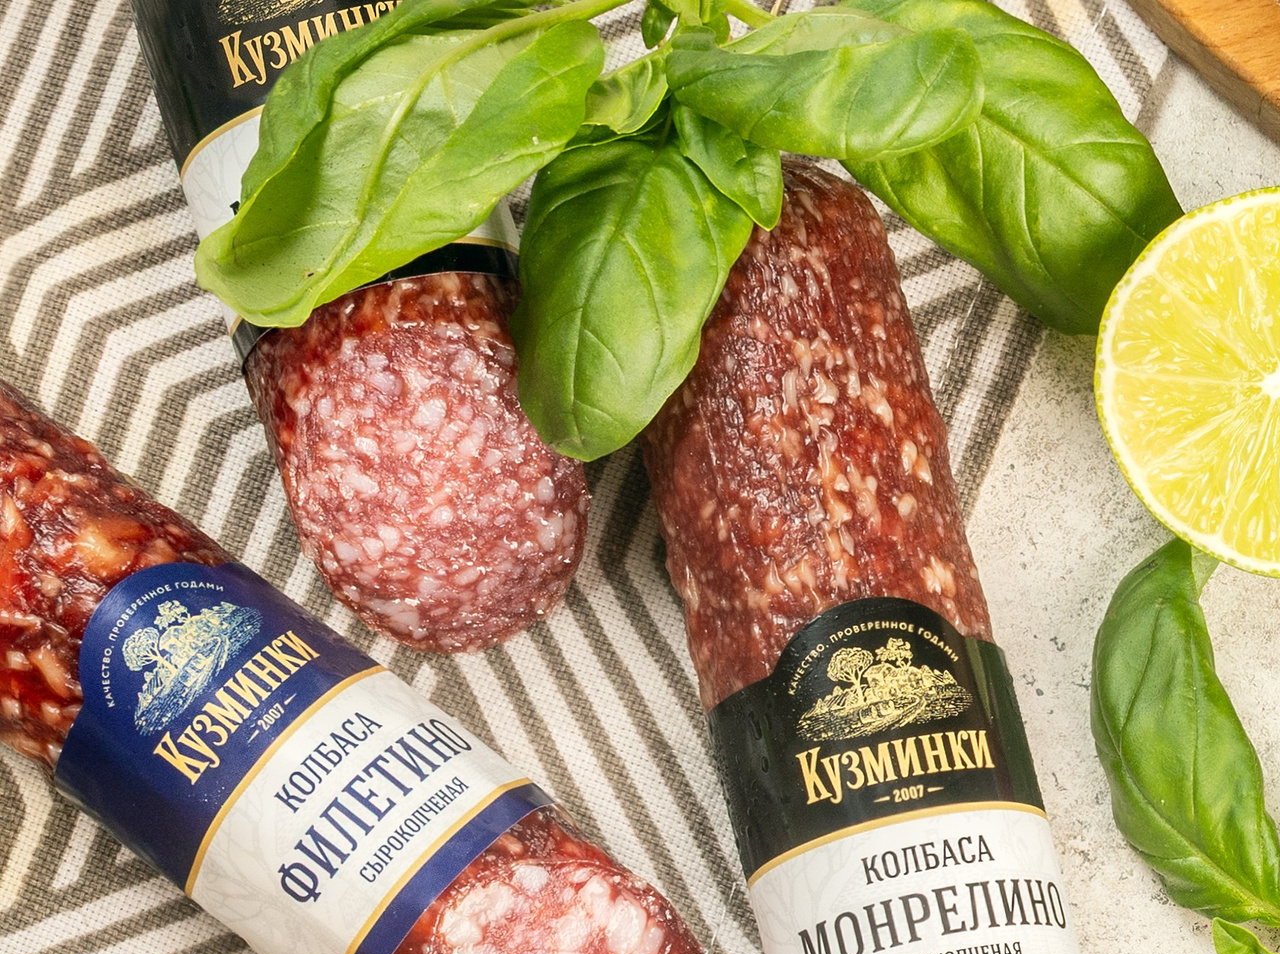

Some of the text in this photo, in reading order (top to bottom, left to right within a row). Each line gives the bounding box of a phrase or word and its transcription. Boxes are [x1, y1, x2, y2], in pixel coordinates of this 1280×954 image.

[219, 0, 402, 88] Кузмин
[108, 584, 172, 642] ПРОВЕРЕННОЕ
[174, 580, 224, 592] ГОДАМИ
[829, 620, 915, 643] ПРОВЕРЕННОЕ
[917, 627, 959, 663] ГОДАМИ
[257, 703, 286, 732] 2007
[273, 711, 383, 813] КОЛБАСА
[277, 718, 473, 903] ФИЛЕТИНО
[893, 784, 926, 803] 2007
[359, 776, 470, 883] СЫРОКОПЧЕНАЯ
[861, 834, 995, 885] КОЛБАСА
